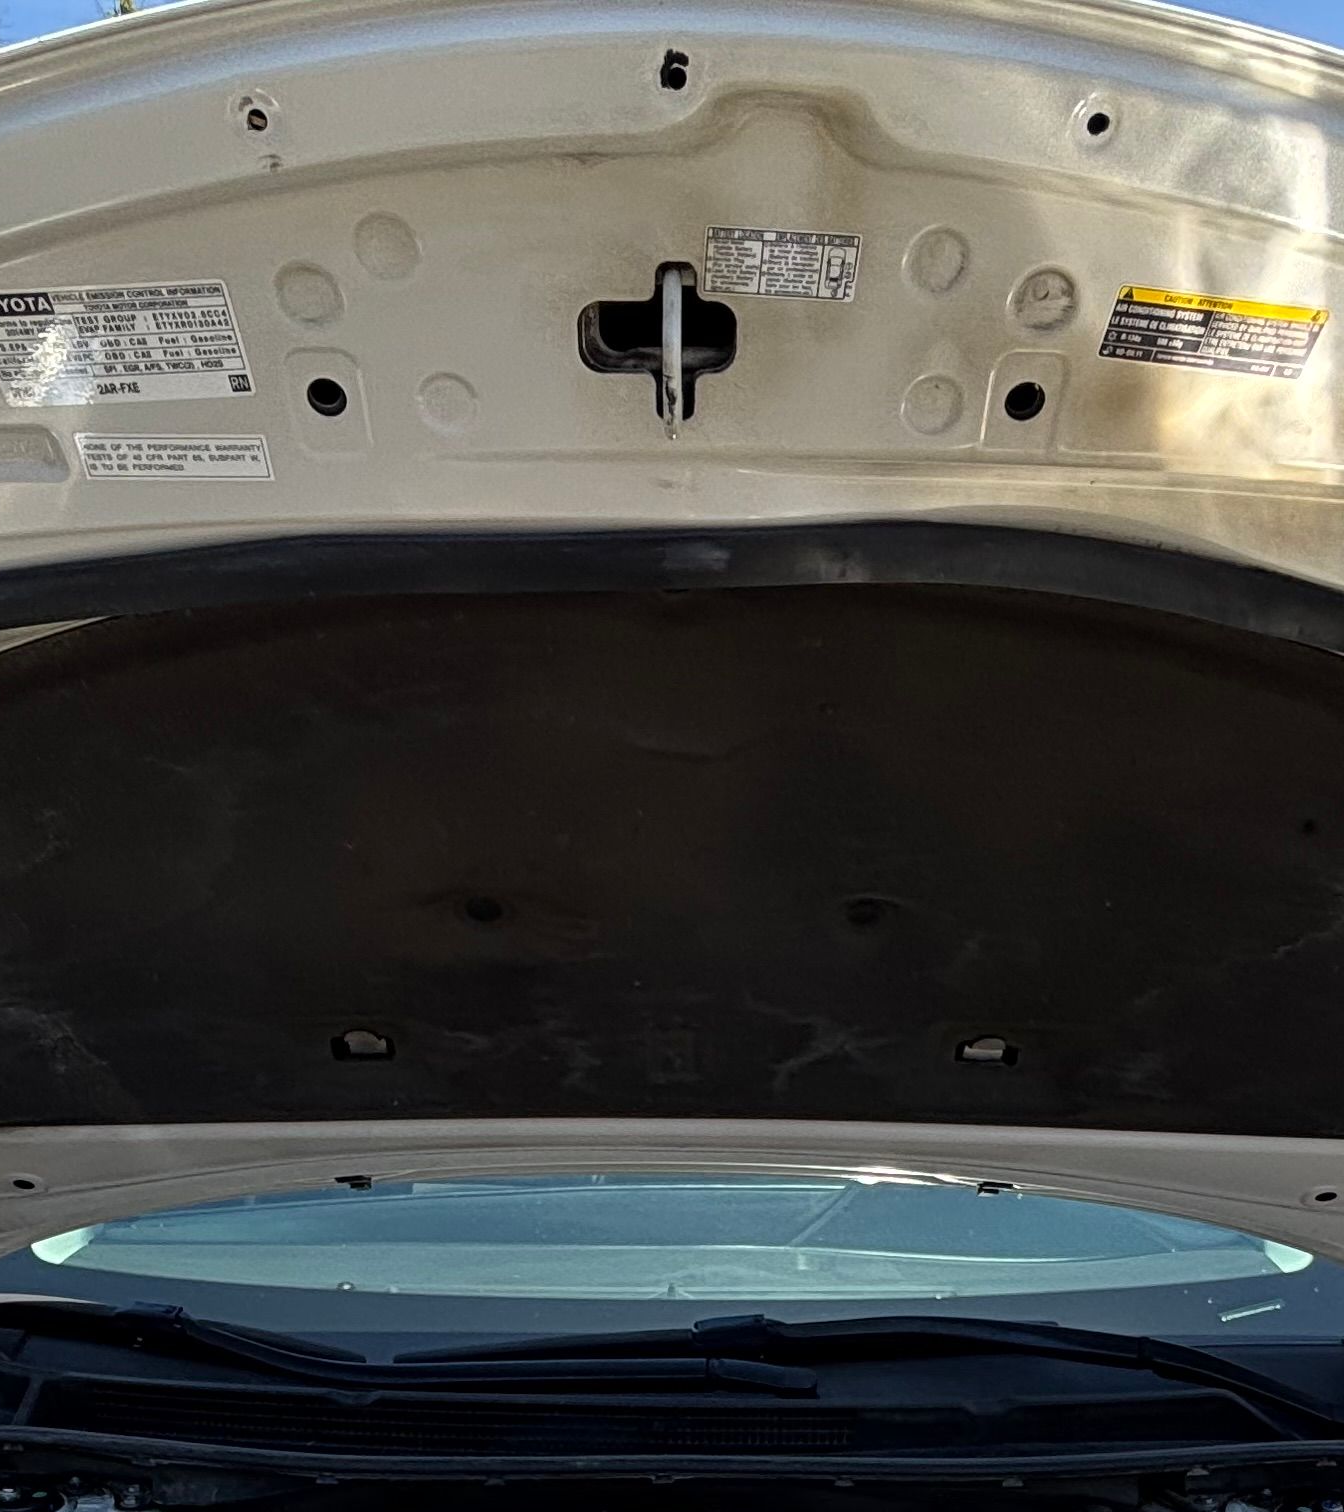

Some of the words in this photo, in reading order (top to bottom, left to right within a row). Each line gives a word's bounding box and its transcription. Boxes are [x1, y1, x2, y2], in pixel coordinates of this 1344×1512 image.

[126, 289, 164, 299] CONTROL
[166, 286, 221, 297] INFORMATION
[1164, 295, 1193, 305] CAUTION
[1197, 297, 1233, 309] ATTENTION
[1116, 303, 1128, 312] AIR
[1176, 310, 1204, 321] SYSTEM
[76, 315, 99, 324] TEST
[103, 314, 136, 324] GROUP
[103, 324, 136, 333] FAMILY
[96, 382, 141, 395] 2AR-FXE
[231, 376, 250, 391] RN
[126, 443, 144, 451] THE
[147, 443, 211, 452] PERFORMANCE
[167, 454, 188, 462] PART
